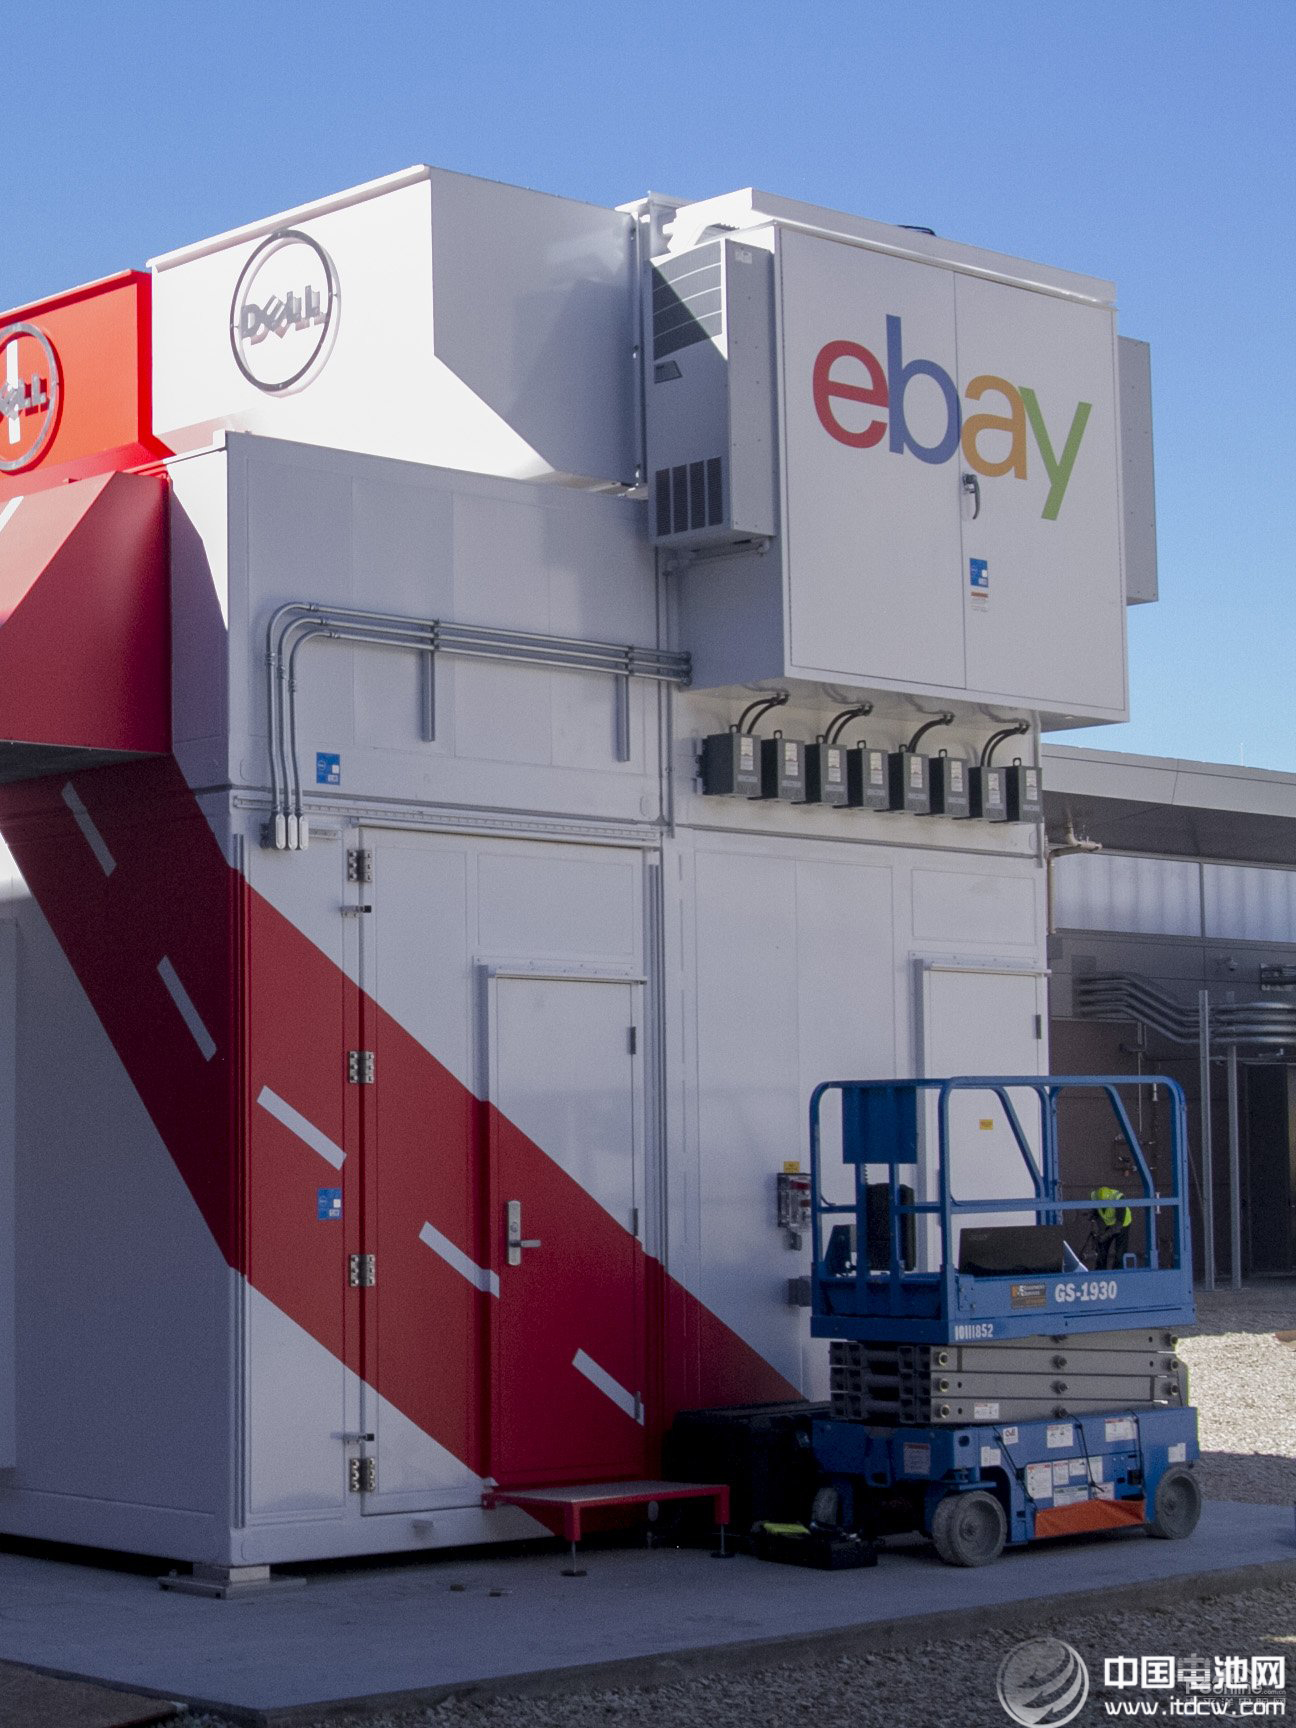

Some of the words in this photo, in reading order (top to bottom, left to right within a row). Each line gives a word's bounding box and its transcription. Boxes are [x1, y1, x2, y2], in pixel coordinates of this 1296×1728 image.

[241, 285, 320, 338] DELL
[813, 314, 1092, 521] ebay
[1055, 1281, 1117, 1302] GS-1930
